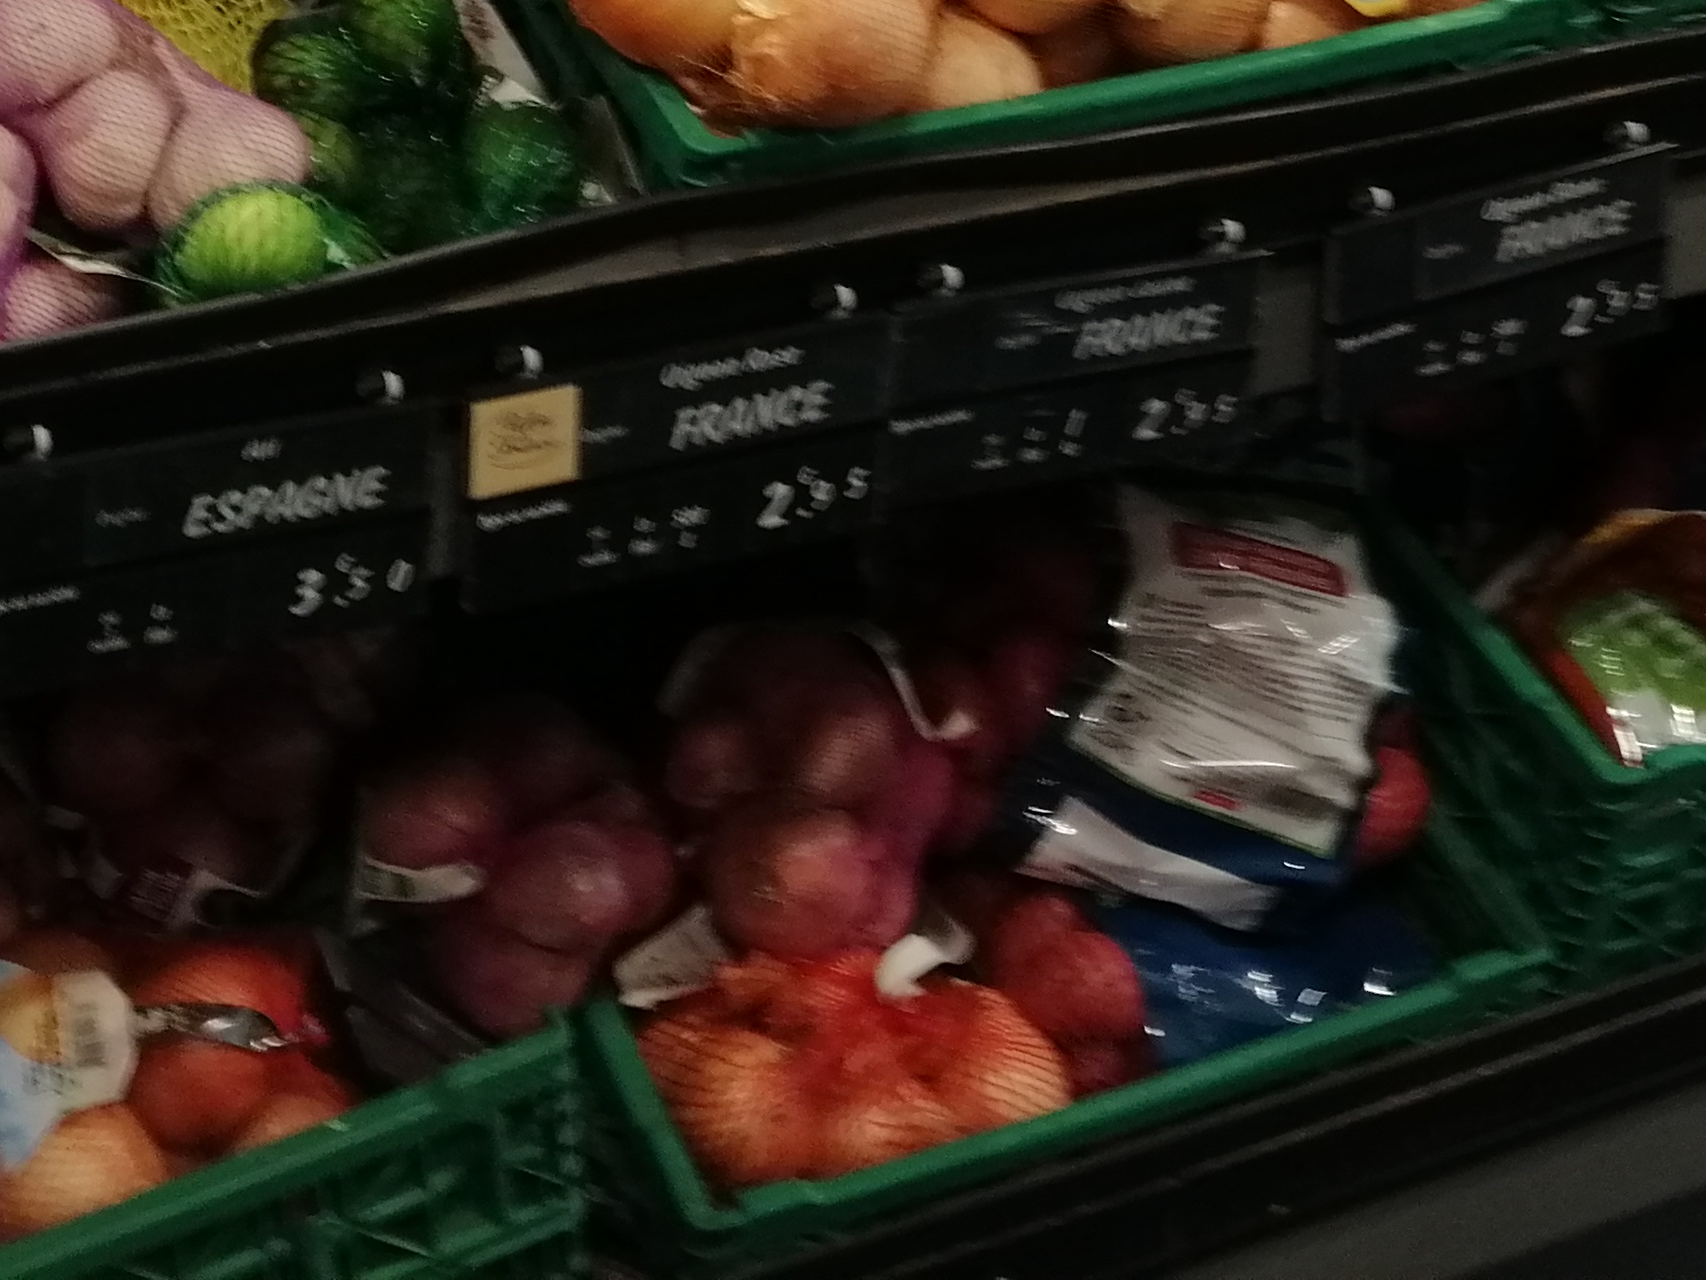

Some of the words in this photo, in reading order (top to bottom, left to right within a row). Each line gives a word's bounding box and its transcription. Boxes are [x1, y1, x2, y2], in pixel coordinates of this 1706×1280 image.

[1071, 302, 1226, 360] FRANCE
[667, 378, 835, 452] FRANCE
[183, 464, 392, 539] ESPAGNE
